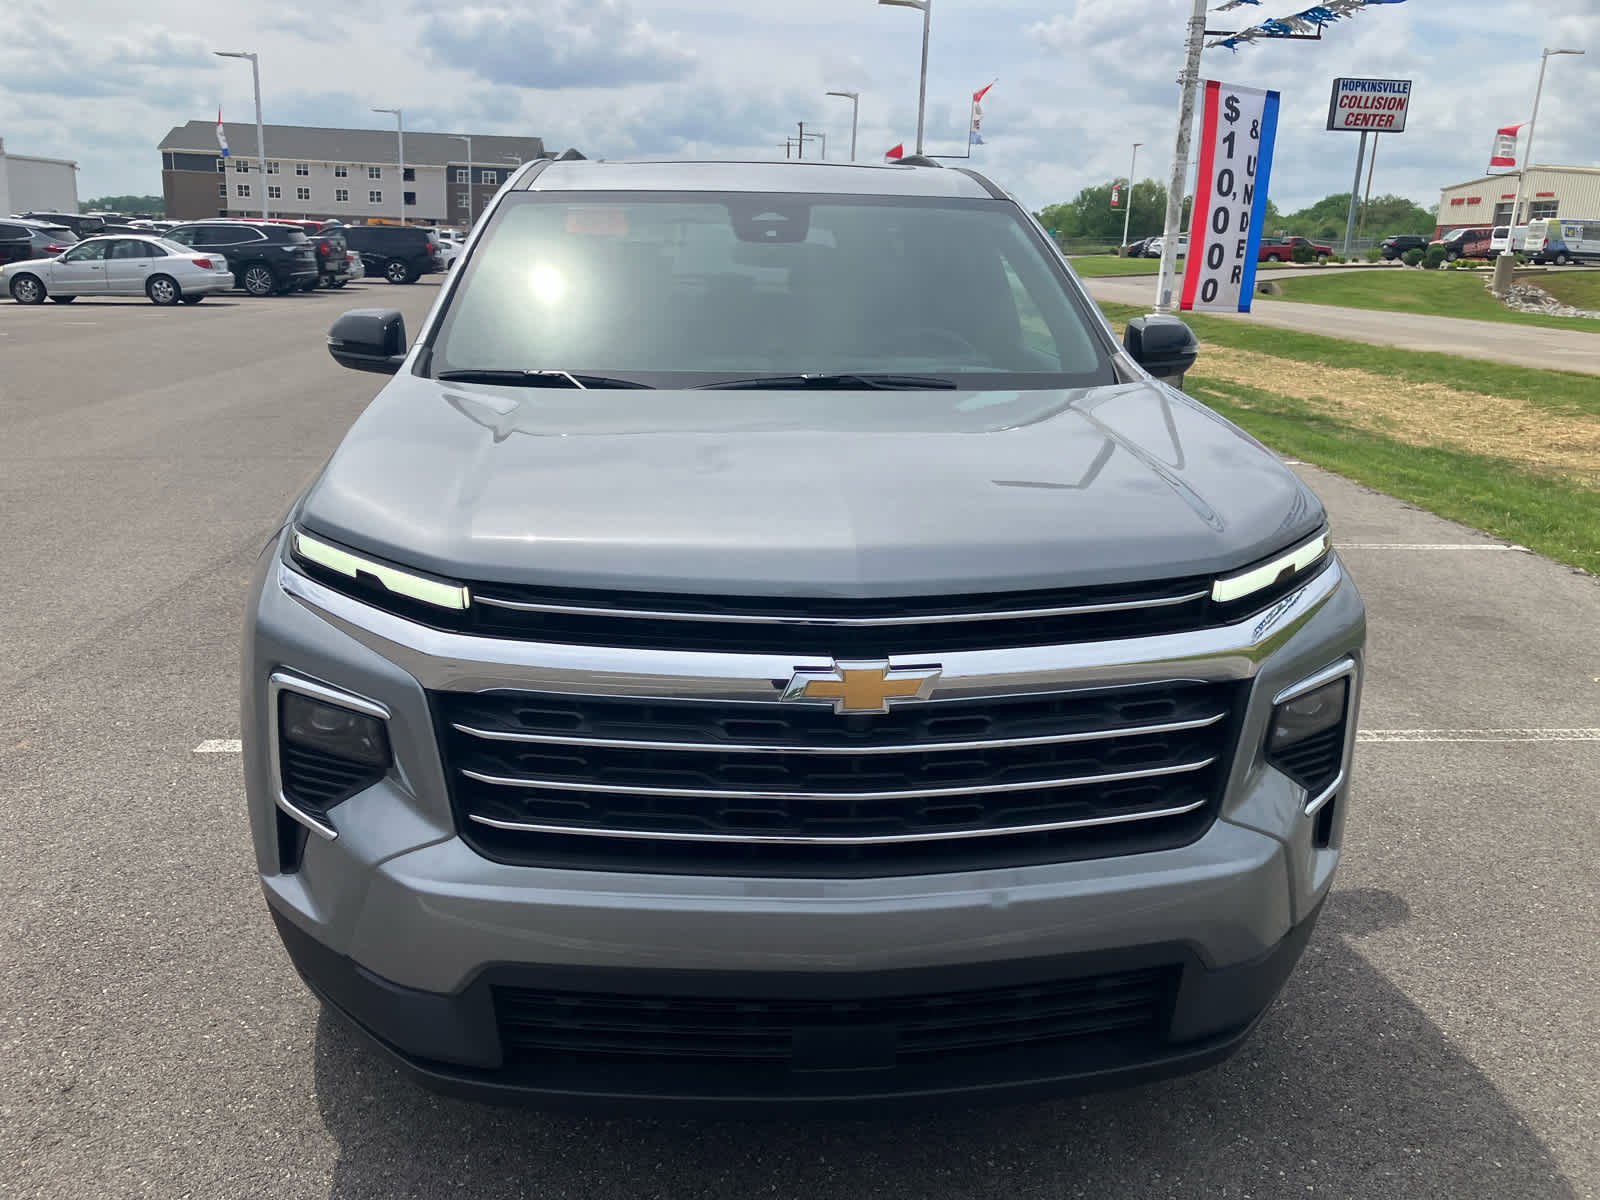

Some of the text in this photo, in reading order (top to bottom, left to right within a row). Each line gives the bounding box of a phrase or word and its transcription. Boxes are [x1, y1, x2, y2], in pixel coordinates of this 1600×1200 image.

[1341, 80, 1409, 94] HOPKINSVILLE
[1339, 95, 1406, 112] COLLISION
[1344, 112, 1395, 128] CENTER
[1201, 94, 1241, 303] $10,000
[1230, 119, 1259, 284] & UNDER
